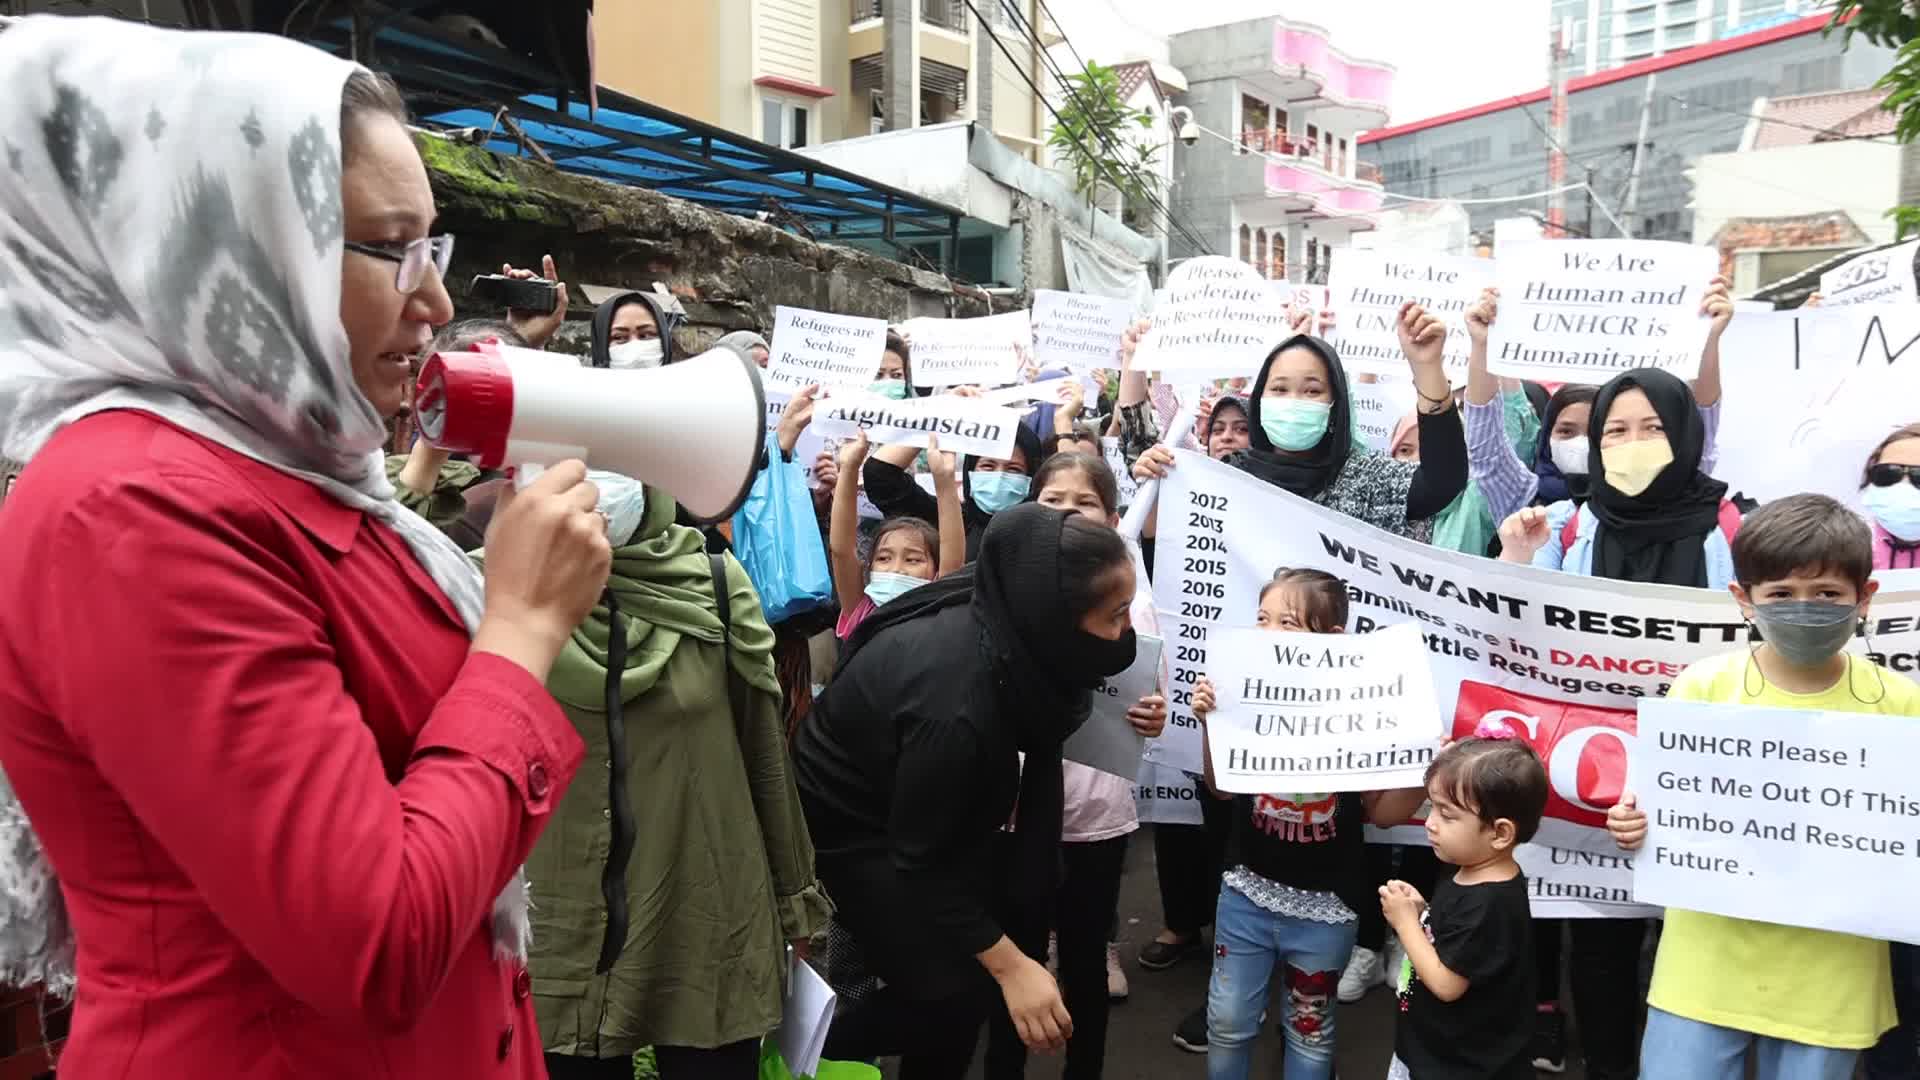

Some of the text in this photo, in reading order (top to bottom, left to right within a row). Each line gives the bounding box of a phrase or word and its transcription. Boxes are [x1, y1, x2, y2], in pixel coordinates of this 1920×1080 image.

[1188, 262, 1243, 280] Please
[1384, 262, 1459, 283] We Are
[1564, 252, 1655, 273] We Are
[1066, 297, 1101, 311] Please
[1168, 284, 1262, 305] Accelerate
[1351, 287, 1432, 310] Human
[1522, 282, 1688, 305] Human and
[790, 314, 875, 339] Refugees are
[1050, 309, 1111, 326] Accelerate
[1532, 313, 1670, 336] UNHCR is
[804, 337, 856, 359] Seeking
[1046, 336, 1111, 353] Procedures
[1158, 327, 1265, 349] Procedures
[1500, 342, 1689, 370] Humanitarian
[771, 368, 791, 384] for
[1189, 491, 1229, 512] 2012
[1188, 512, 1224, 534] 2013
[1186, 534, 1228, 554] 2014
[1183, 557, 1227, 576] 2015
[1318, 531, 1382, 575] WE
[1389, 561, 1528, 619] WANT
[1182, 579, 1225, 599] 2016
[1180, 601, 1223, 622] 2017
[1179, 623, 1207, 641] 201
[1454, 622, 1500, 646] are
[1509, 638, 1540, 661] in
[1176, 645, 1206, 664] 201
[1274, 644, 1364, 669] We Are
[1489, 652, 1646, 698] Refugees
[1242, 673, 1404, 703] Human and
[1254, 711, 1399, 737] UNHCR is
[1228, 744, 1434, 772] Humanitarian
[1659, 731, 1867, 768] UNHCR Please !
[1140, 786, 1152, 800] it
[1657, 771, 1920, 817] Get Me Out Of This
[1657, 808, 1734, 834] Limbo
[1743, 818, 1796, 842] And
[1806, 825, 1905, 856] Rescue
[1655, 846, 1739, 874] Future
